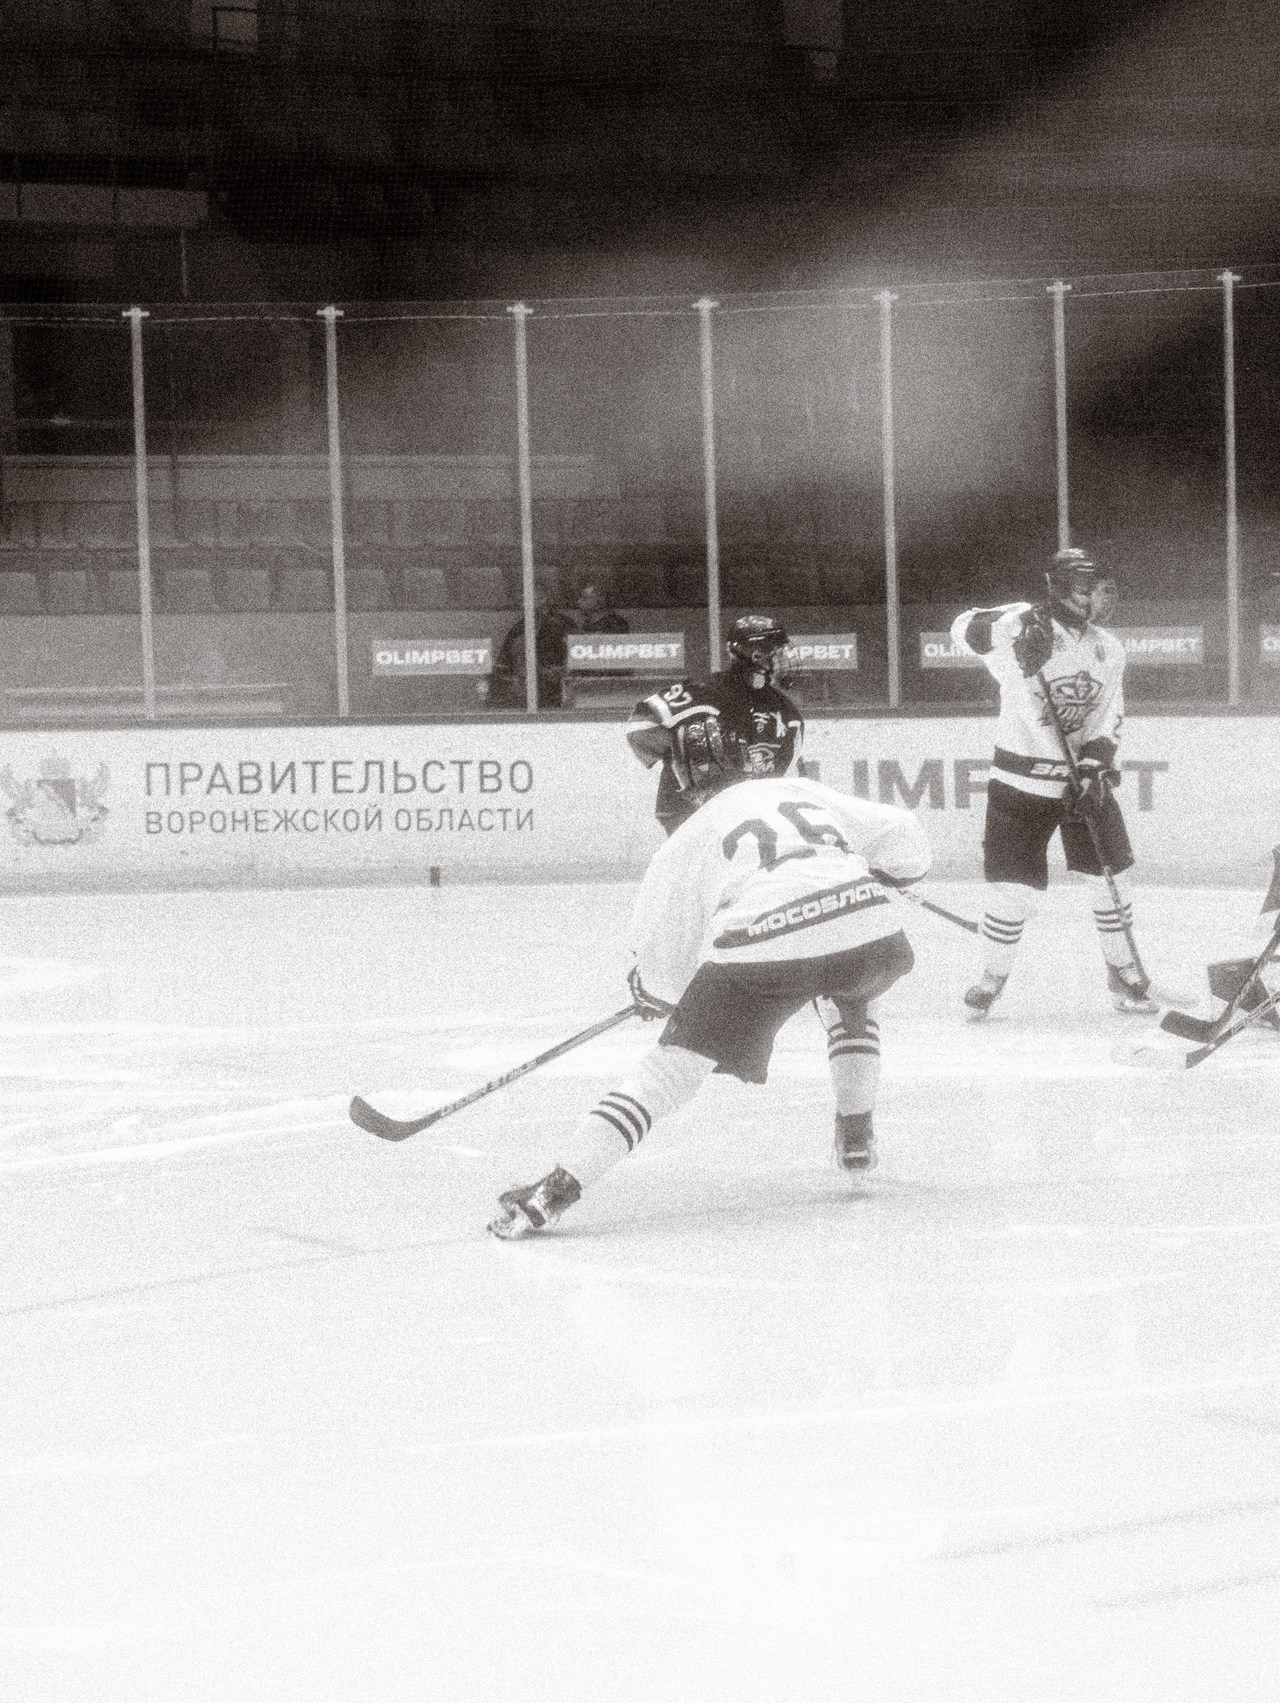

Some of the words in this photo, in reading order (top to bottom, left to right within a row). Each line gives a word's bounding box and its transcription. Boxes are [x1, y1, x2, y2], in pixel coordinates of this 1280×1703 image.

[375, 647, 488, 666] OLIMPBET
[569, 641, 682, 661] OLIMPBET
[145, 760, 535, 796] ПРАВИТЕЛЬСТВО
[145, 803, 384, 835] ВОРОНЕЖСКОЙ
[393, 807, 535, 833] ОБЛАСТИ
